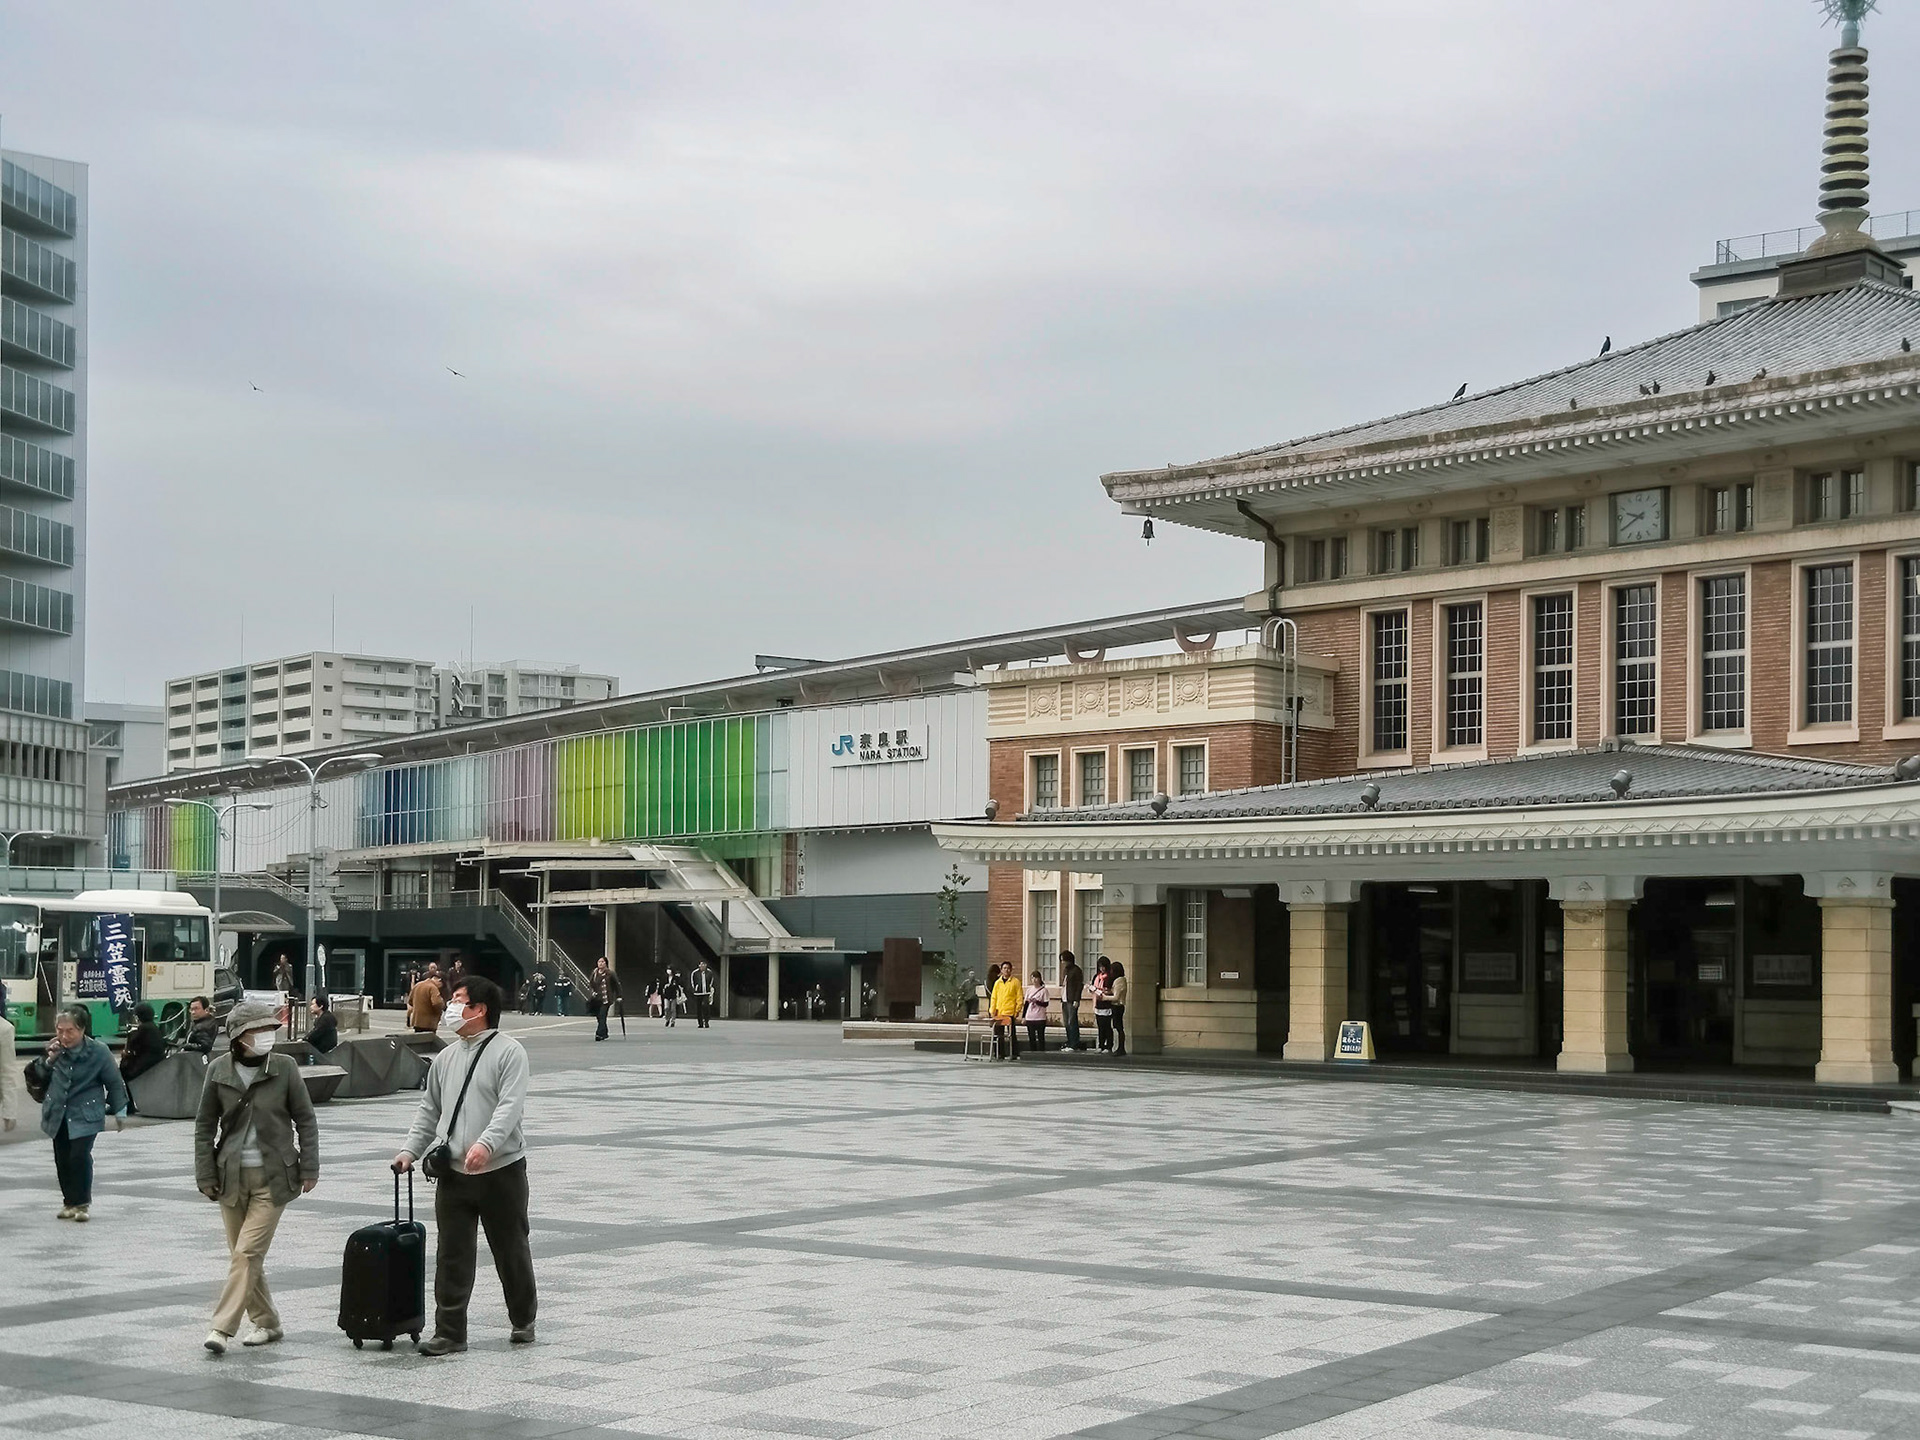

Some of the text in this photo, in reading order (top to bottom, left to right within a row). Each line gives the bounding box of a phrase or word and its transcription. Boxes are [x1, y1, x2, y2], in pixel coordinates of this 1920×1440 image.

[832, 734, 855, 756] JR
[859, 729, 909, 749] 奈良駅
[859, 746, 922, 761] NARA STATION
[105, 922, 133, 1007] 三笠霊苑
